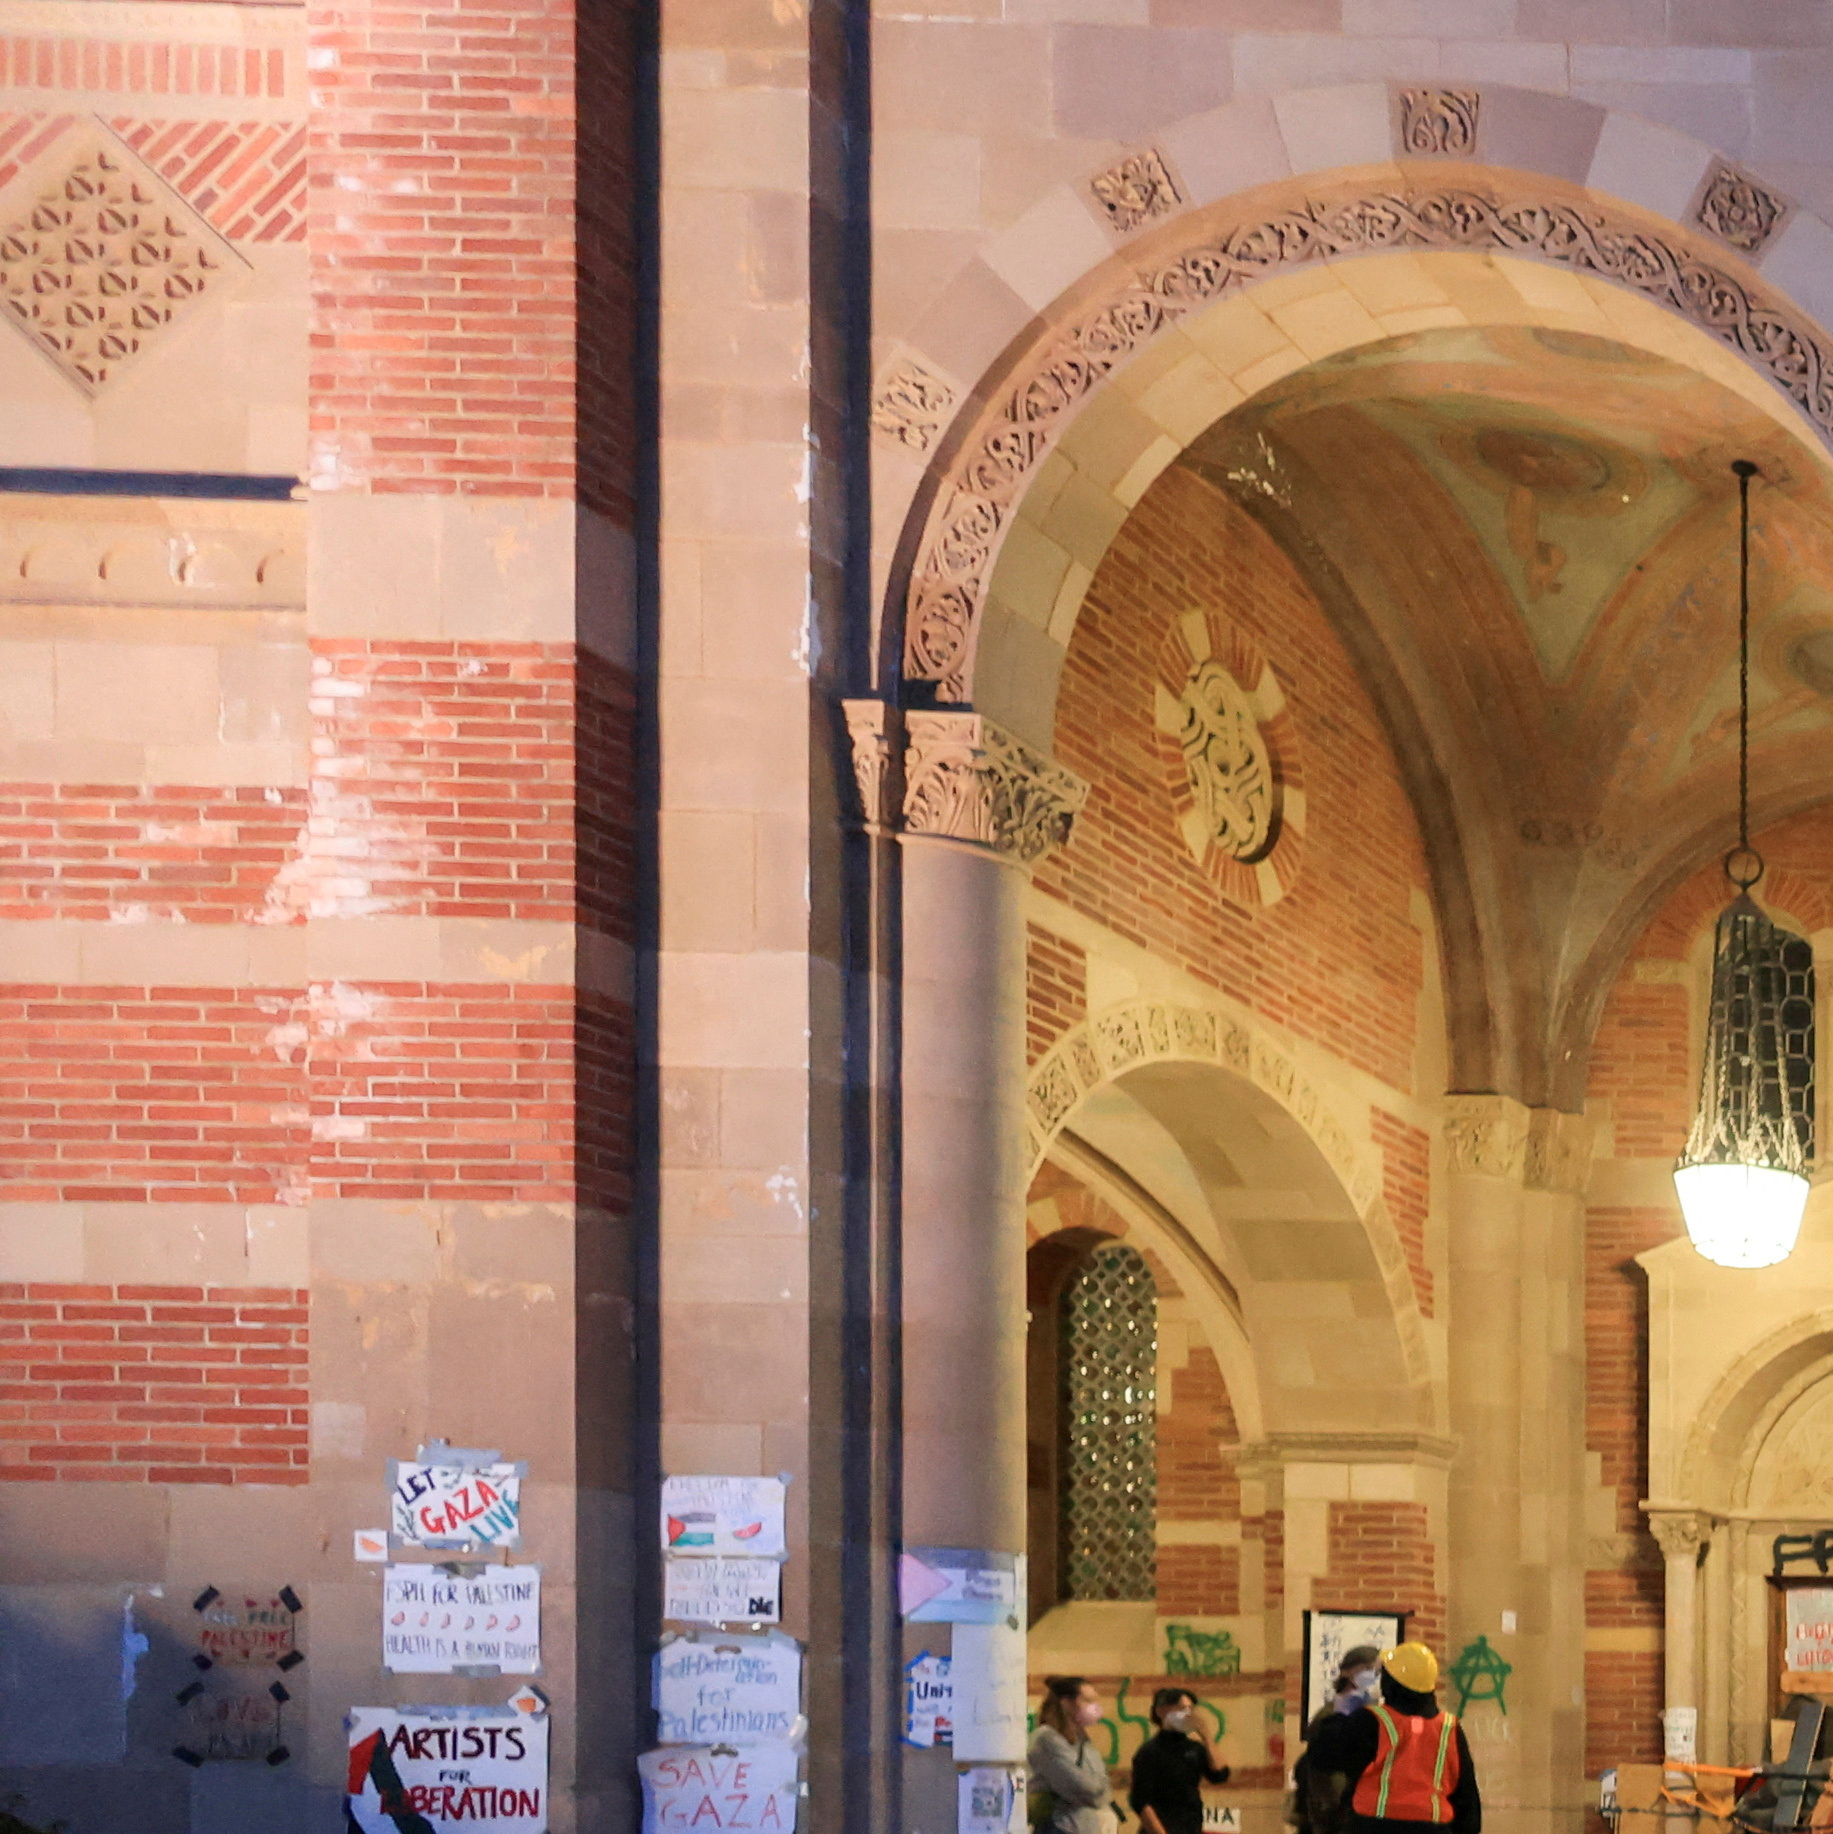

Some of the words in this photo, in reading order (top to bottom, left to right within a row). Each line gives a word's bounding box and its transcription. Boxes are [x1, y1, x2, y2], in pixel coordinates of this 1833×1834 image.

[397, 1468, 436, 1504] LET
[420, 1480, 499, 1535] GAZA
[469, 1489, 519, 1542] LIVE
[431, 1581, 458, 1606] FOR
[465, 1581, 535, 1606] PALESTINE
[201, 1629, 289, 1648] PALESTINE
[386, 1634, 431, 1657] HEALTH
[435, 1639, 447, 1659] IS
[451, 1641, 460, 1660] A
[697, 1685, 737, 1707] for
[658, 1706, 790, 1739] Palestinians
[389, 1723, 527, 1763] ARTISTS
[439, 1768, 473, 1785] FOR
[652, 1757, 753, 1790] SAVE
[379, 1785, 541, 1821] LIBERATION
[660, 1793, 782, 1829] GAZA
